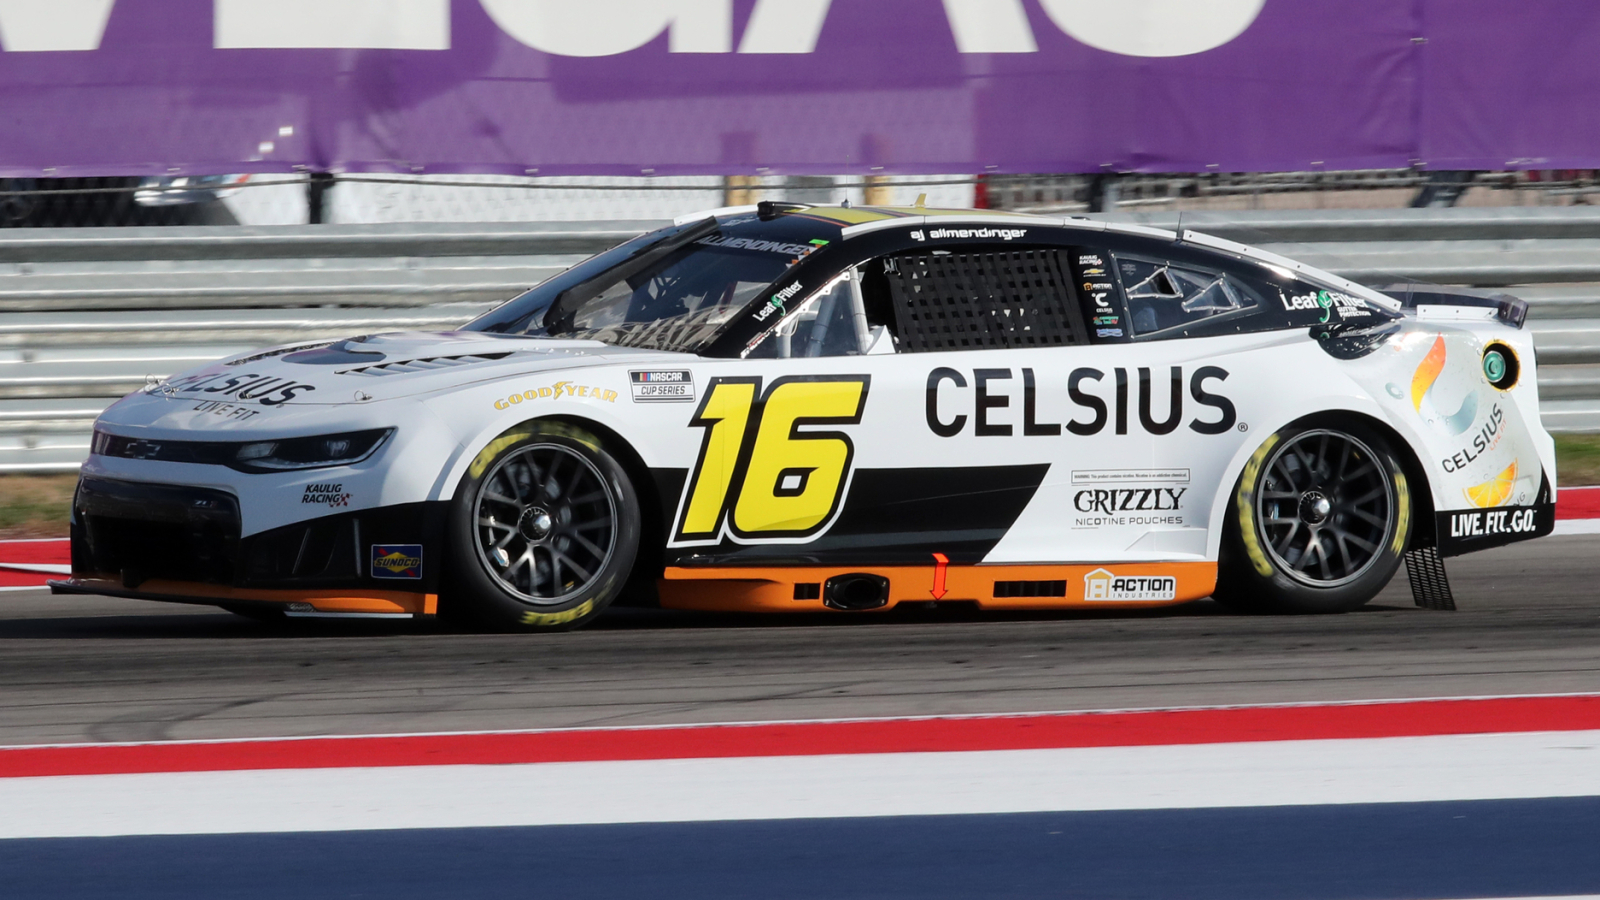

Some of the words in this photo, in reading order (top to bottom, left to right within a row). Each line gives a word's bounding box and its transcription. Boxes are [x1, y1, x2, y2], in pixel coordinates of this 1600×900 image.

[910, 229, 925, 241] aj
[930, 228, 1027, 240] allmendinger
[649, 372, 683, 381] NASCAR
[494, 381, 618, 410] GOODYEAR
[641, 386, 657, 395] CUP
[658, 385, 685, 394] SERIES
[925, 365, 1237, 438] CELSIUS
[193, 400, 234, 416] LIVE
[227, 407, 260, 421] FIT
[1442, 403, 1503, 473] CELSIUS
[667, 373, 872, 548] 16
[305, 484, 342, 493] KAULIG
[302, 494, 340, 503] RACING
[1073, 487, 1187, 515] GRIZZLY
[1076, 517, 1125, 525] NICOTINE
[1129, 516, 1183, 525] POUCHES
[374, 557, 420, 567] SUNOCO
[1112, 578, 1173, 591] ACTION
